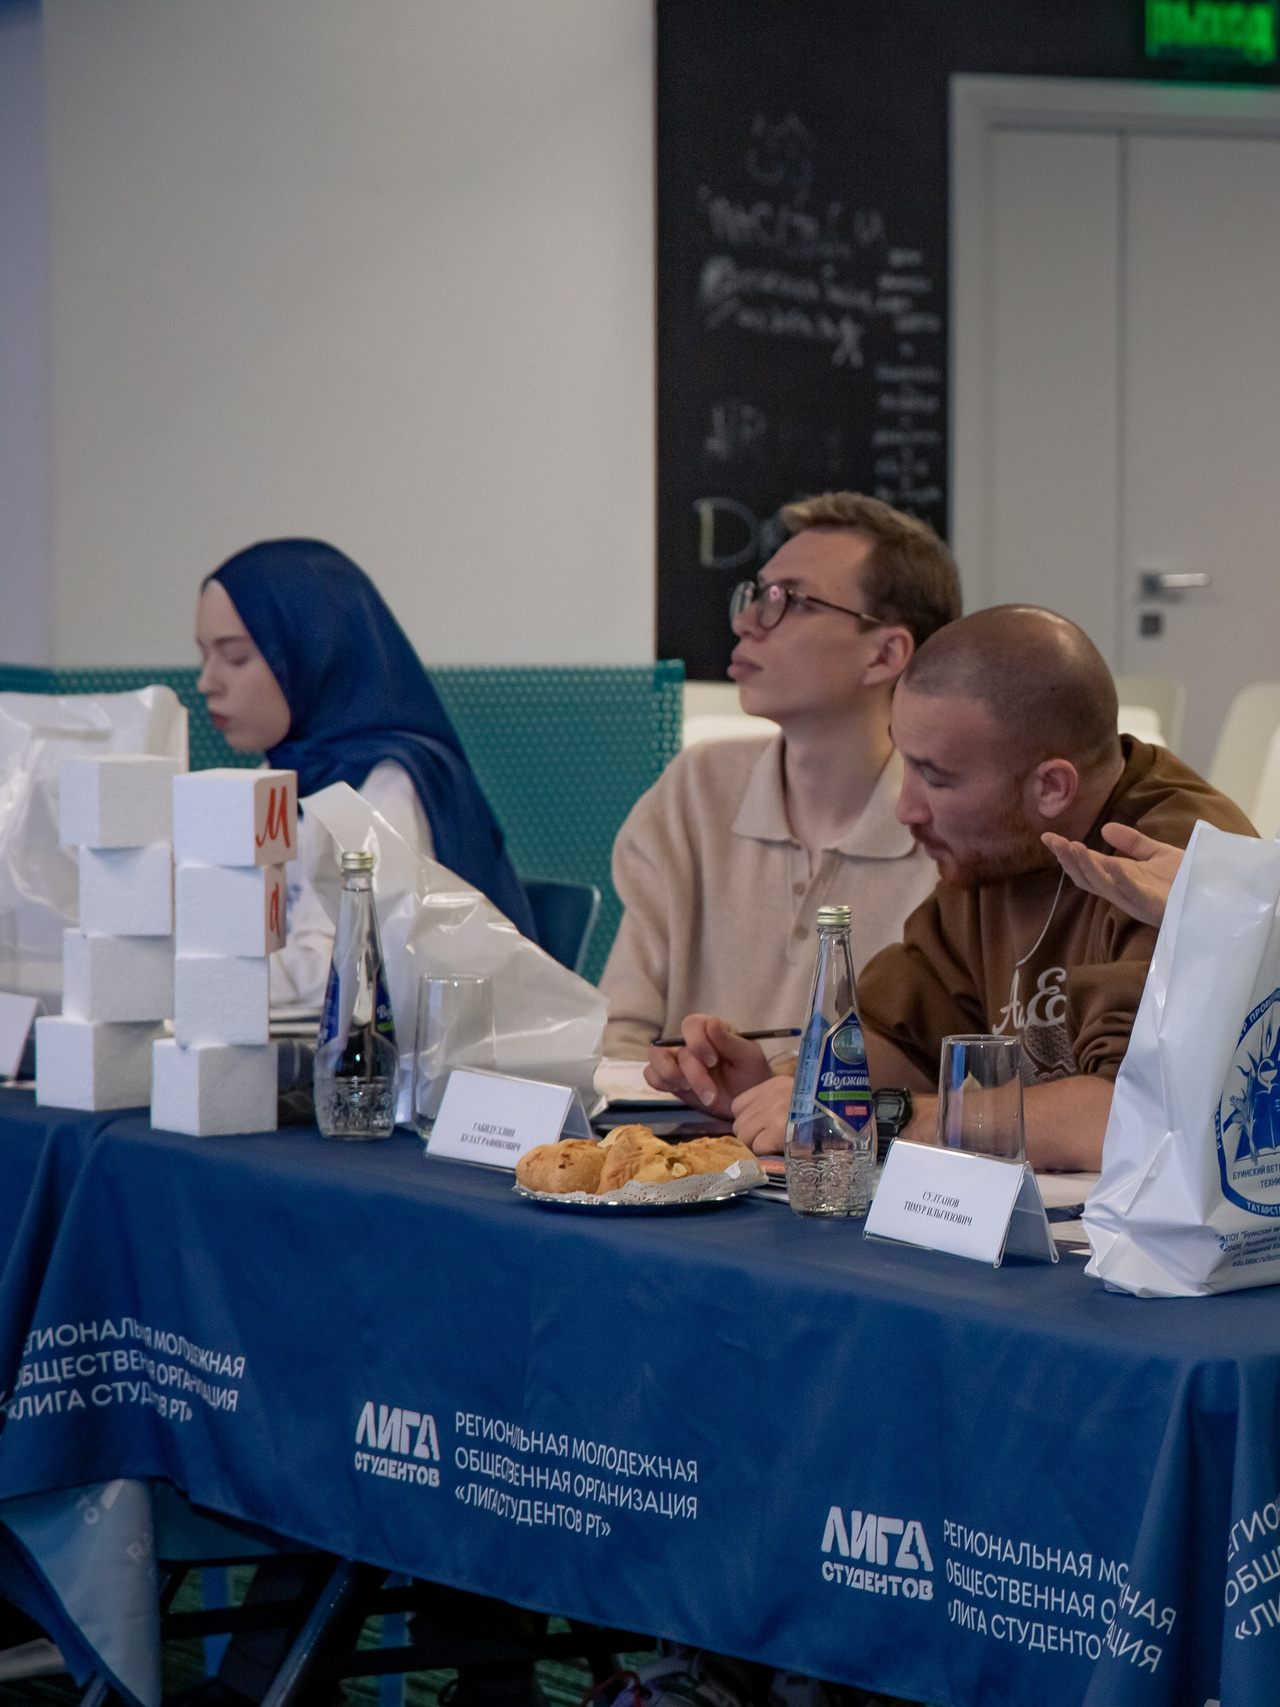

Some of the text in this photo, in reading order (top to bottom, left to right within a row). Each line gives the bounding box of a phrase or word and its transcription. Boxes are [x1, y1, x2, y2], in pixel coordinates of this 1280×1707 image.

[821, 1071, 870, 1090] Волжан
[1232, 1165, 1266, 1180] БУИНСКИЙ
[903, 1201, 973, 1226] ТИМУР ИЛЬГИЗОВИЧ
[922, 1191, 960, 1208] СУЛТАНОВ
[355, 1401, 440, 1461] ЛИГА
[354, 1451, 440, 1488] СТУДЕНТОВ
[571, 1437, 698, 1483] МОЛОДЕЖНАЯ
[454, 1483, 612, 1538] «ЛИГА СТУДЕНТОВ РТ»
[573, 1474, 698, 1520] ОРГАНИЗАЦИЯ
[821, 1505, 934, 1572] ЛИГА
[943, 1518, 1093, 1579] РЕГИОНАЛЬНАЯ
[821, 1560, 934, 1601] СТУДЕНТОВ
[946, 1558, 1095, 1620] ОБЩЕСТВЕННАЯ
[991, 1613, 1101, 1660] СТУДЕНТО
